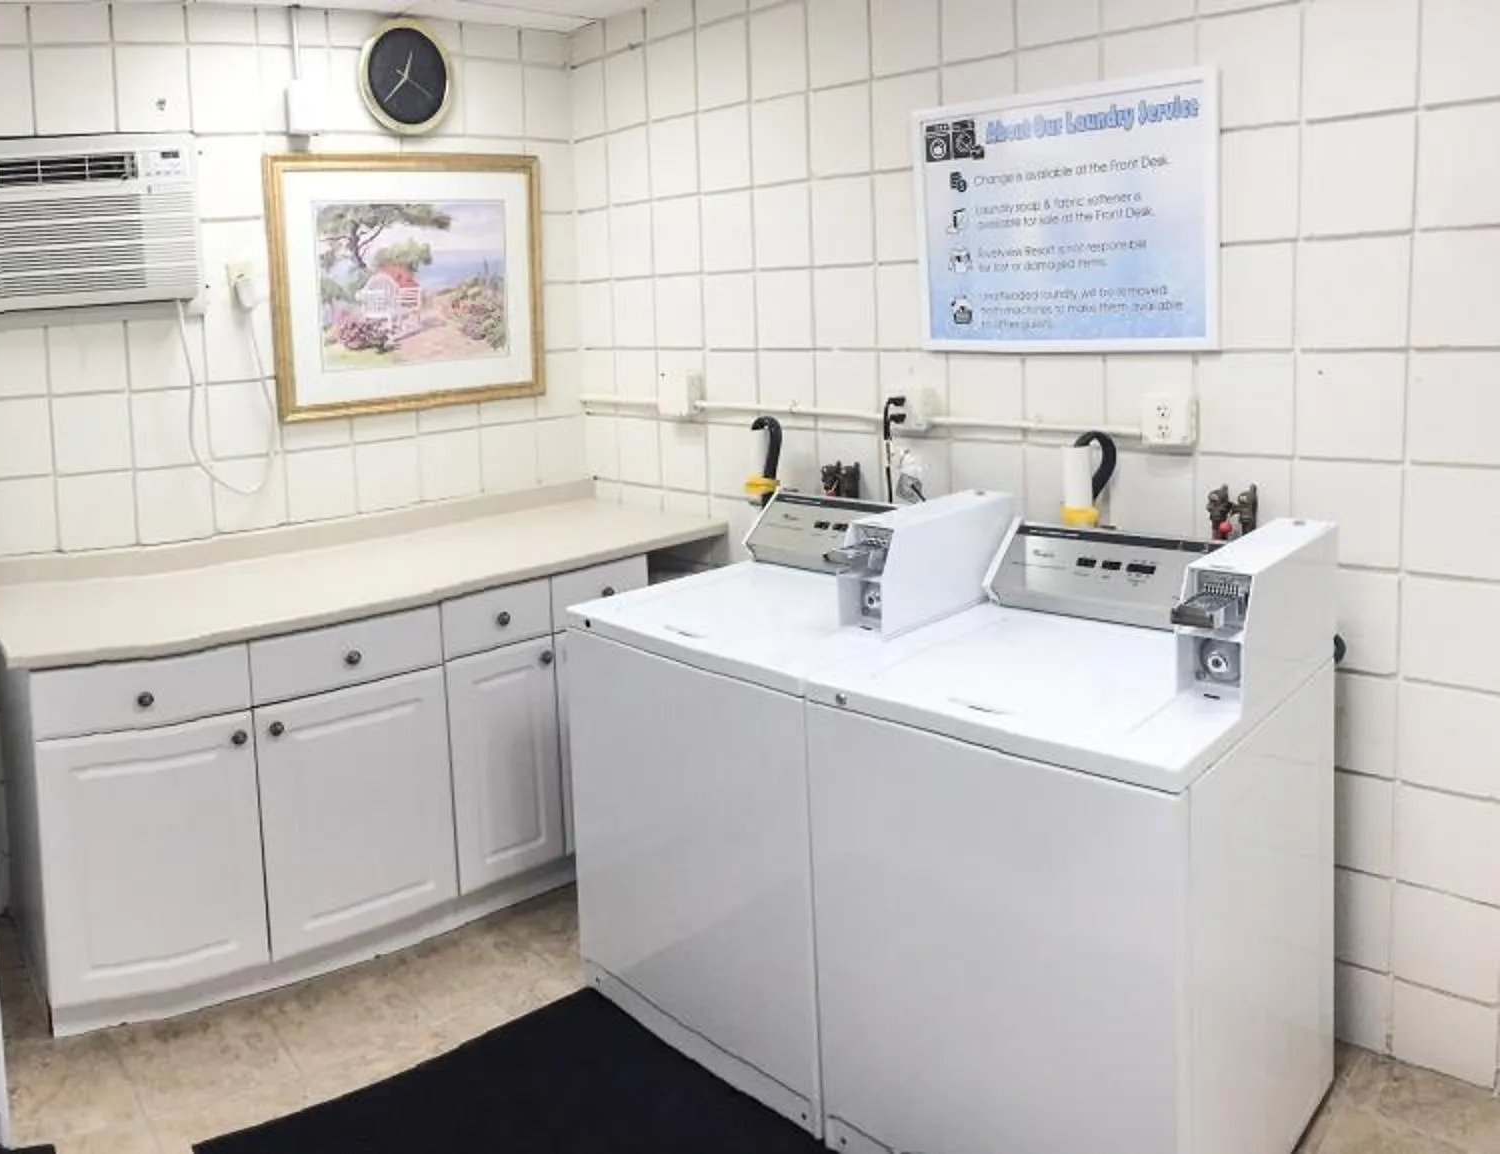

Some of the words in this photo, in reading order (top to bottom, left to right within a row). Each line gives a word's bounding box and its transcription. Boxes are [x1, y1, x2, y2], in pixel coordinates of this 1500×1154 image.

[985, 118, 1031, 144] About
[1033, 114, 1063, 138] Our
[1065, 104, 1135, 135] Laundry
[1137, 95, 1200, 125] Service
[973, 173, 1015, 188] Change
[1025, 162, 1073, 181] available
[1075, 164, 1087, 176] at
[1089, 162, 1108, 174] the
[1109, 158, 1139, 171] Front
[1043, 199, 1051, 211] &
[1053, 196, 1084, 209] fabric
[1087, 192, 1132, 206] softener
[1023, 214, 1037, 227] for
[1039, 212, 1059, 225] sale
[1062, 212, 1074, 223] at
[1075, 210, 1093, 222] the
[1095, 208, 1123, 221] Front
[1024, 244, 1055, 257] Resort
[1023, 256, 1075, 273] damaged
